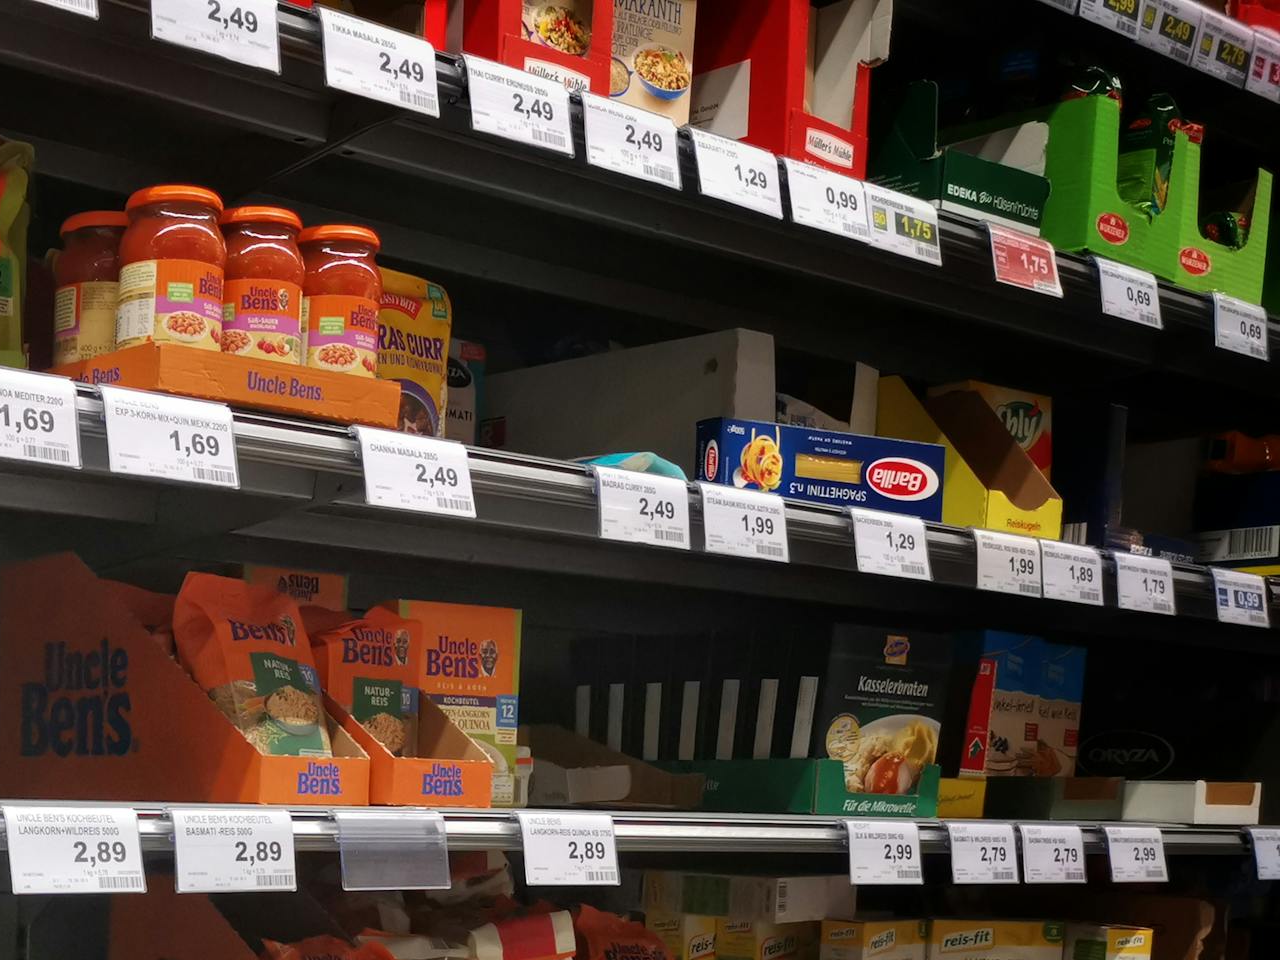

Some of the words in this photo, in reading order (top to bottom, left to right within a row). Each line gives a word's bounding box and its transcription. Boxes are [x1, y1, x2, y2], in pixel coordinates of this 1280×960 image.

[378, 52, 424, 84] 2,49
[513, 93, 554, 122] 2,49
[625, 124, 663, 152] 2,49
[734, 163, 767, 190] 1,29
[826, 186, 858, 212] 0,99
[947, 184, 978, 202] EDEKA
[902, 214, 932, 241] 1,75
[1020, 252, 1048, 275] 1,75
[1126, 286, 1150, 307] 0,69
[168, 429, 220, 457] 1,69
[415, 463, 458, 488] 2,49
[872, 468, 922, 491] Barilla
[807, 484, 867, 502] SPAGHETTINI
[638, 498, 674, 521] 2,49
[741, 514, 774, 536] 1,99
[1006, 517, 1041, 532] Reiskugeln
[886, 531, 916, 552] 1,29
[1008, 556, 1034, 576] 1,99
[1068, 564, 1093, 582] 1,89
[1142, 576, 1165, 595] 1,79
[438, 636, 478, 656] Uncle
[44, 637, 129, 690] Uncle
[857, 676, 928, 698] Kasselerbraten
[842, 799, 856, 812] Für
[858, 800, 870, 812] die
[871, 800, 917, 814] Mikrowelle
[74, 840, 126, 866] 2,89
[234, 840, 282, 864] 2,89
[568, 841, 605, 863] 2,89
[884, 844, 913, 862] 2,99
[980, 846, 1006, 864] 2,79
[1053, 848, 1078, 864] 2,79
[942, 929, 994, 950] reis-fit
